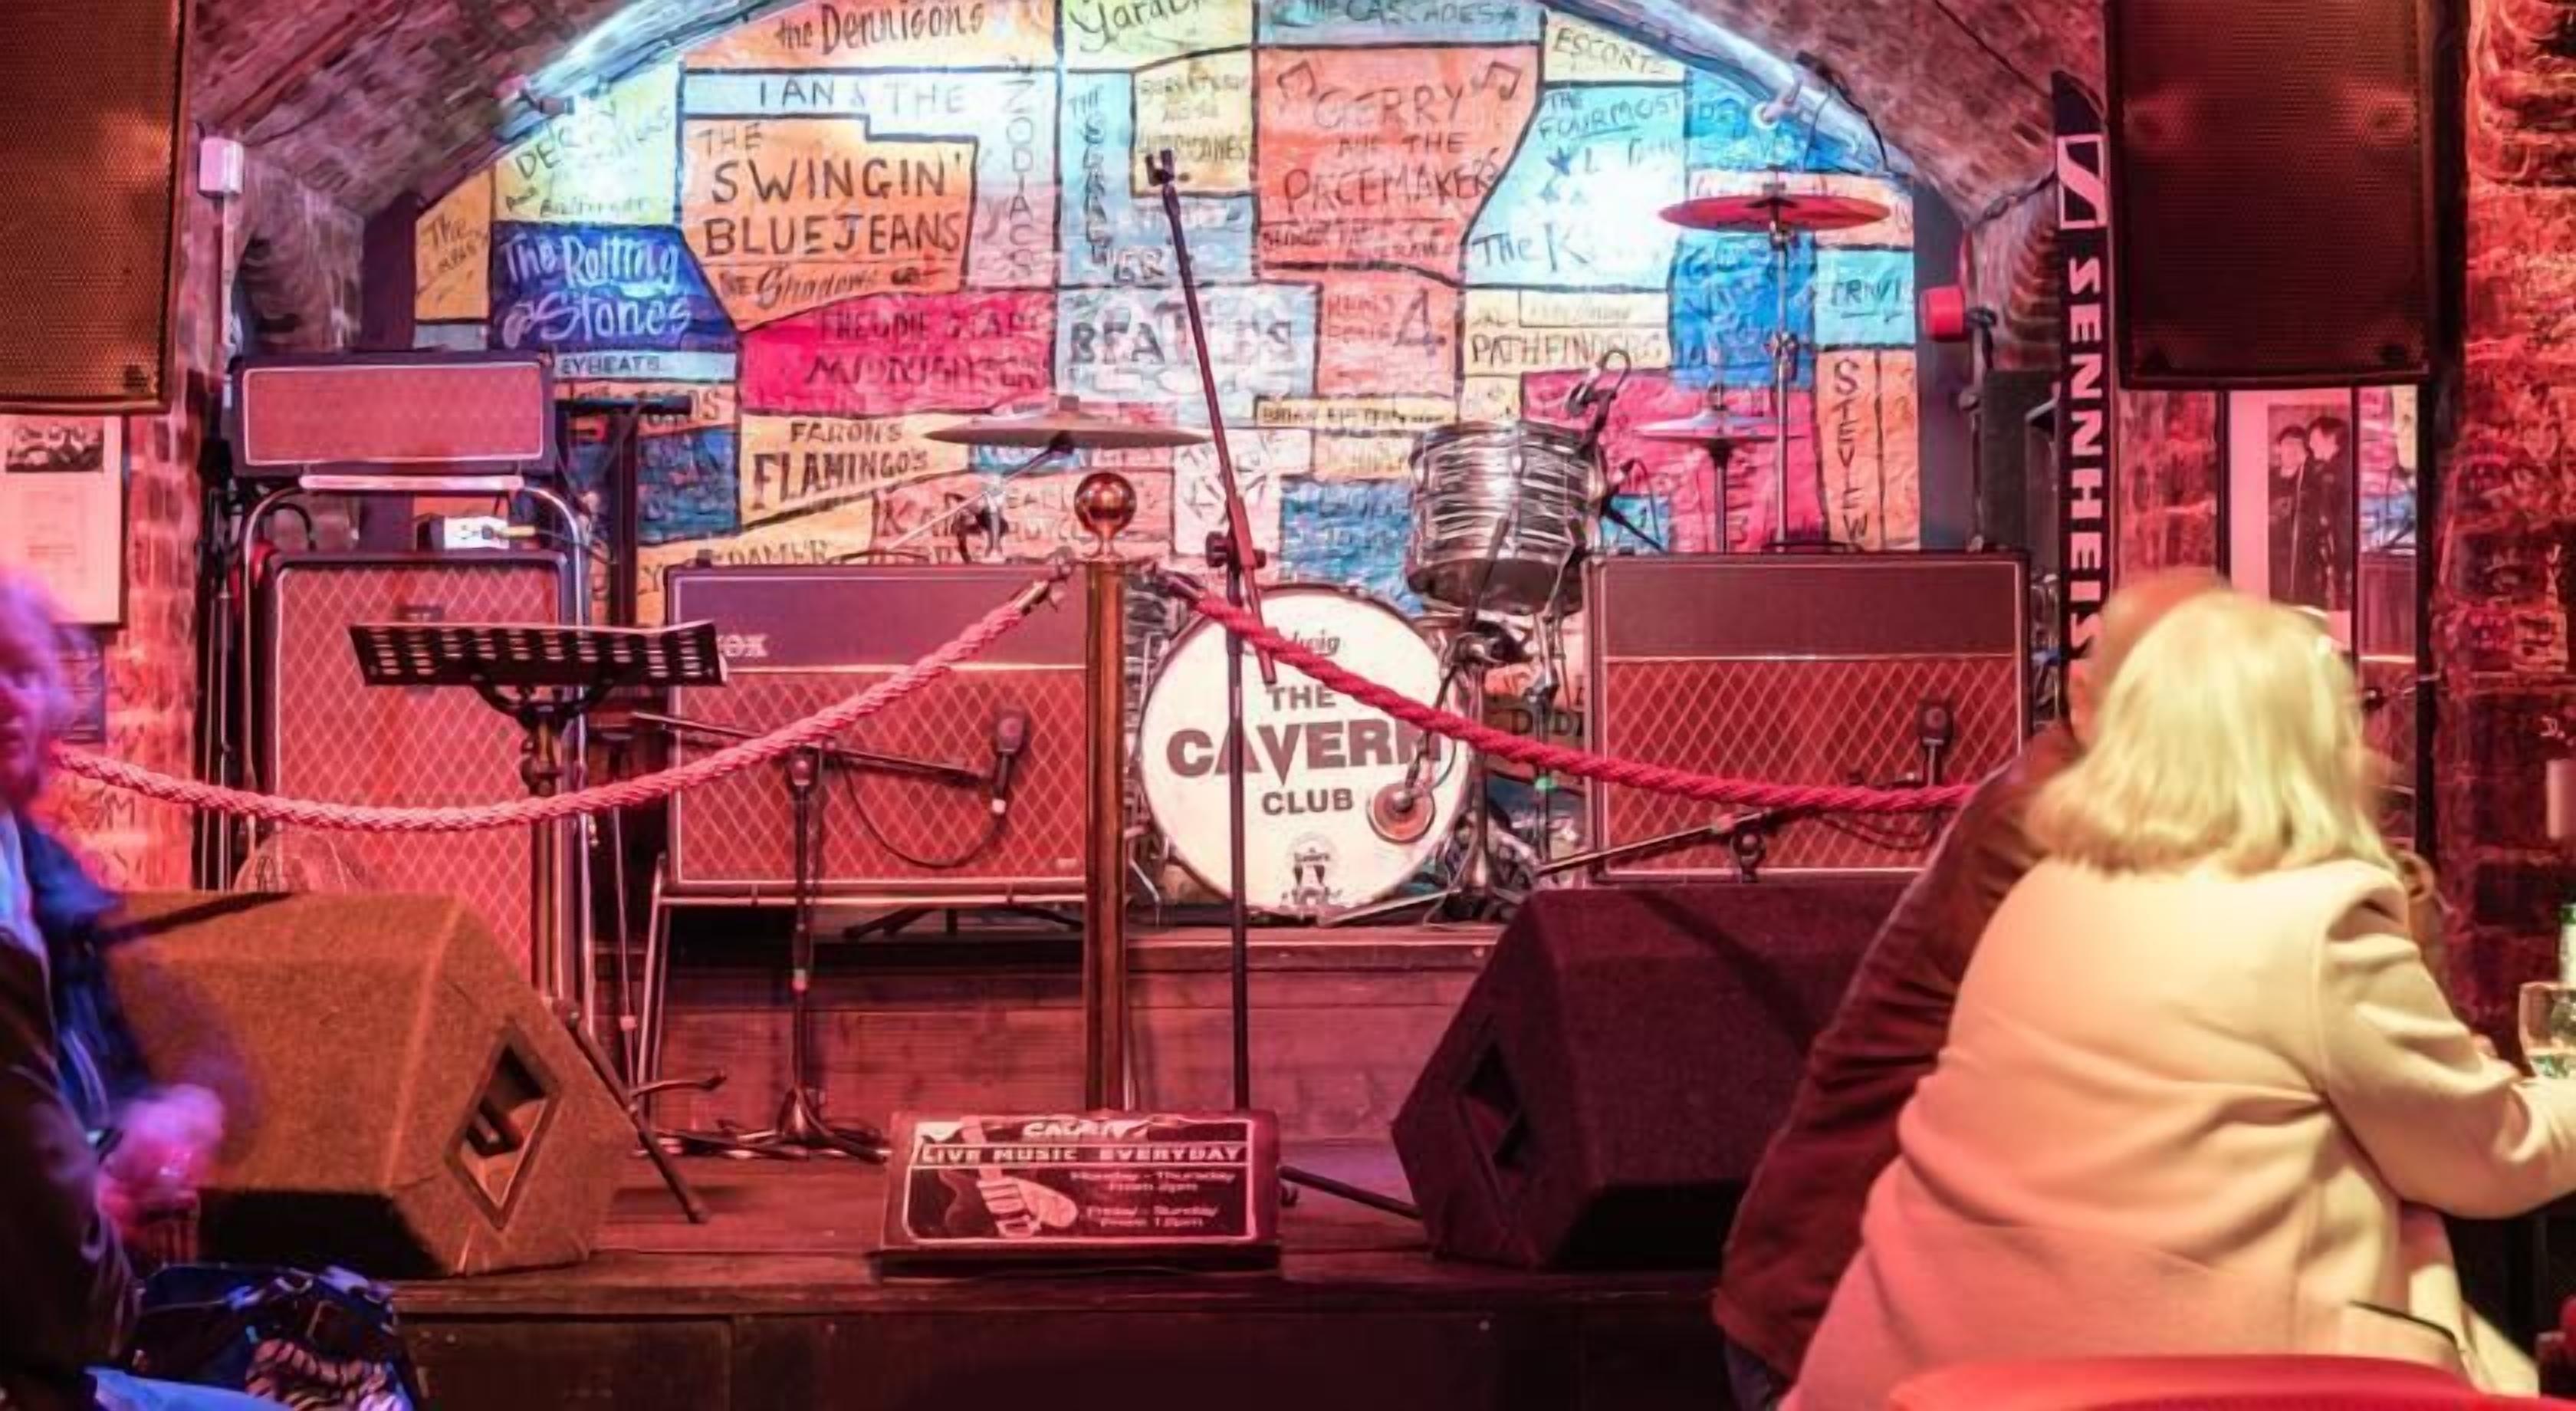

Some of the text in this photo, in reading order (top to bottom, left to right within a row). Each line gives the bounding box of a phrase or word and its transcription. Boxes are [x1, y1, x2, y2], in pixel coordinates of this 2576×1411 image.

[759, 81, 836, 107] IAN
[882, 81, 966, 114] THE
[695, 123, 762, 154] THE
[1401, 131, 1466, 154] THE
[2068, 257, 2103, 656] SENNHEIS
[1265, 686, 1336, 711] THE
[1261, 788, 1353, 816] CLUB
[993, 1149, 1079, 1163] MUSIC
[1099, 1146, 1240, 1162] EVERYDAY
